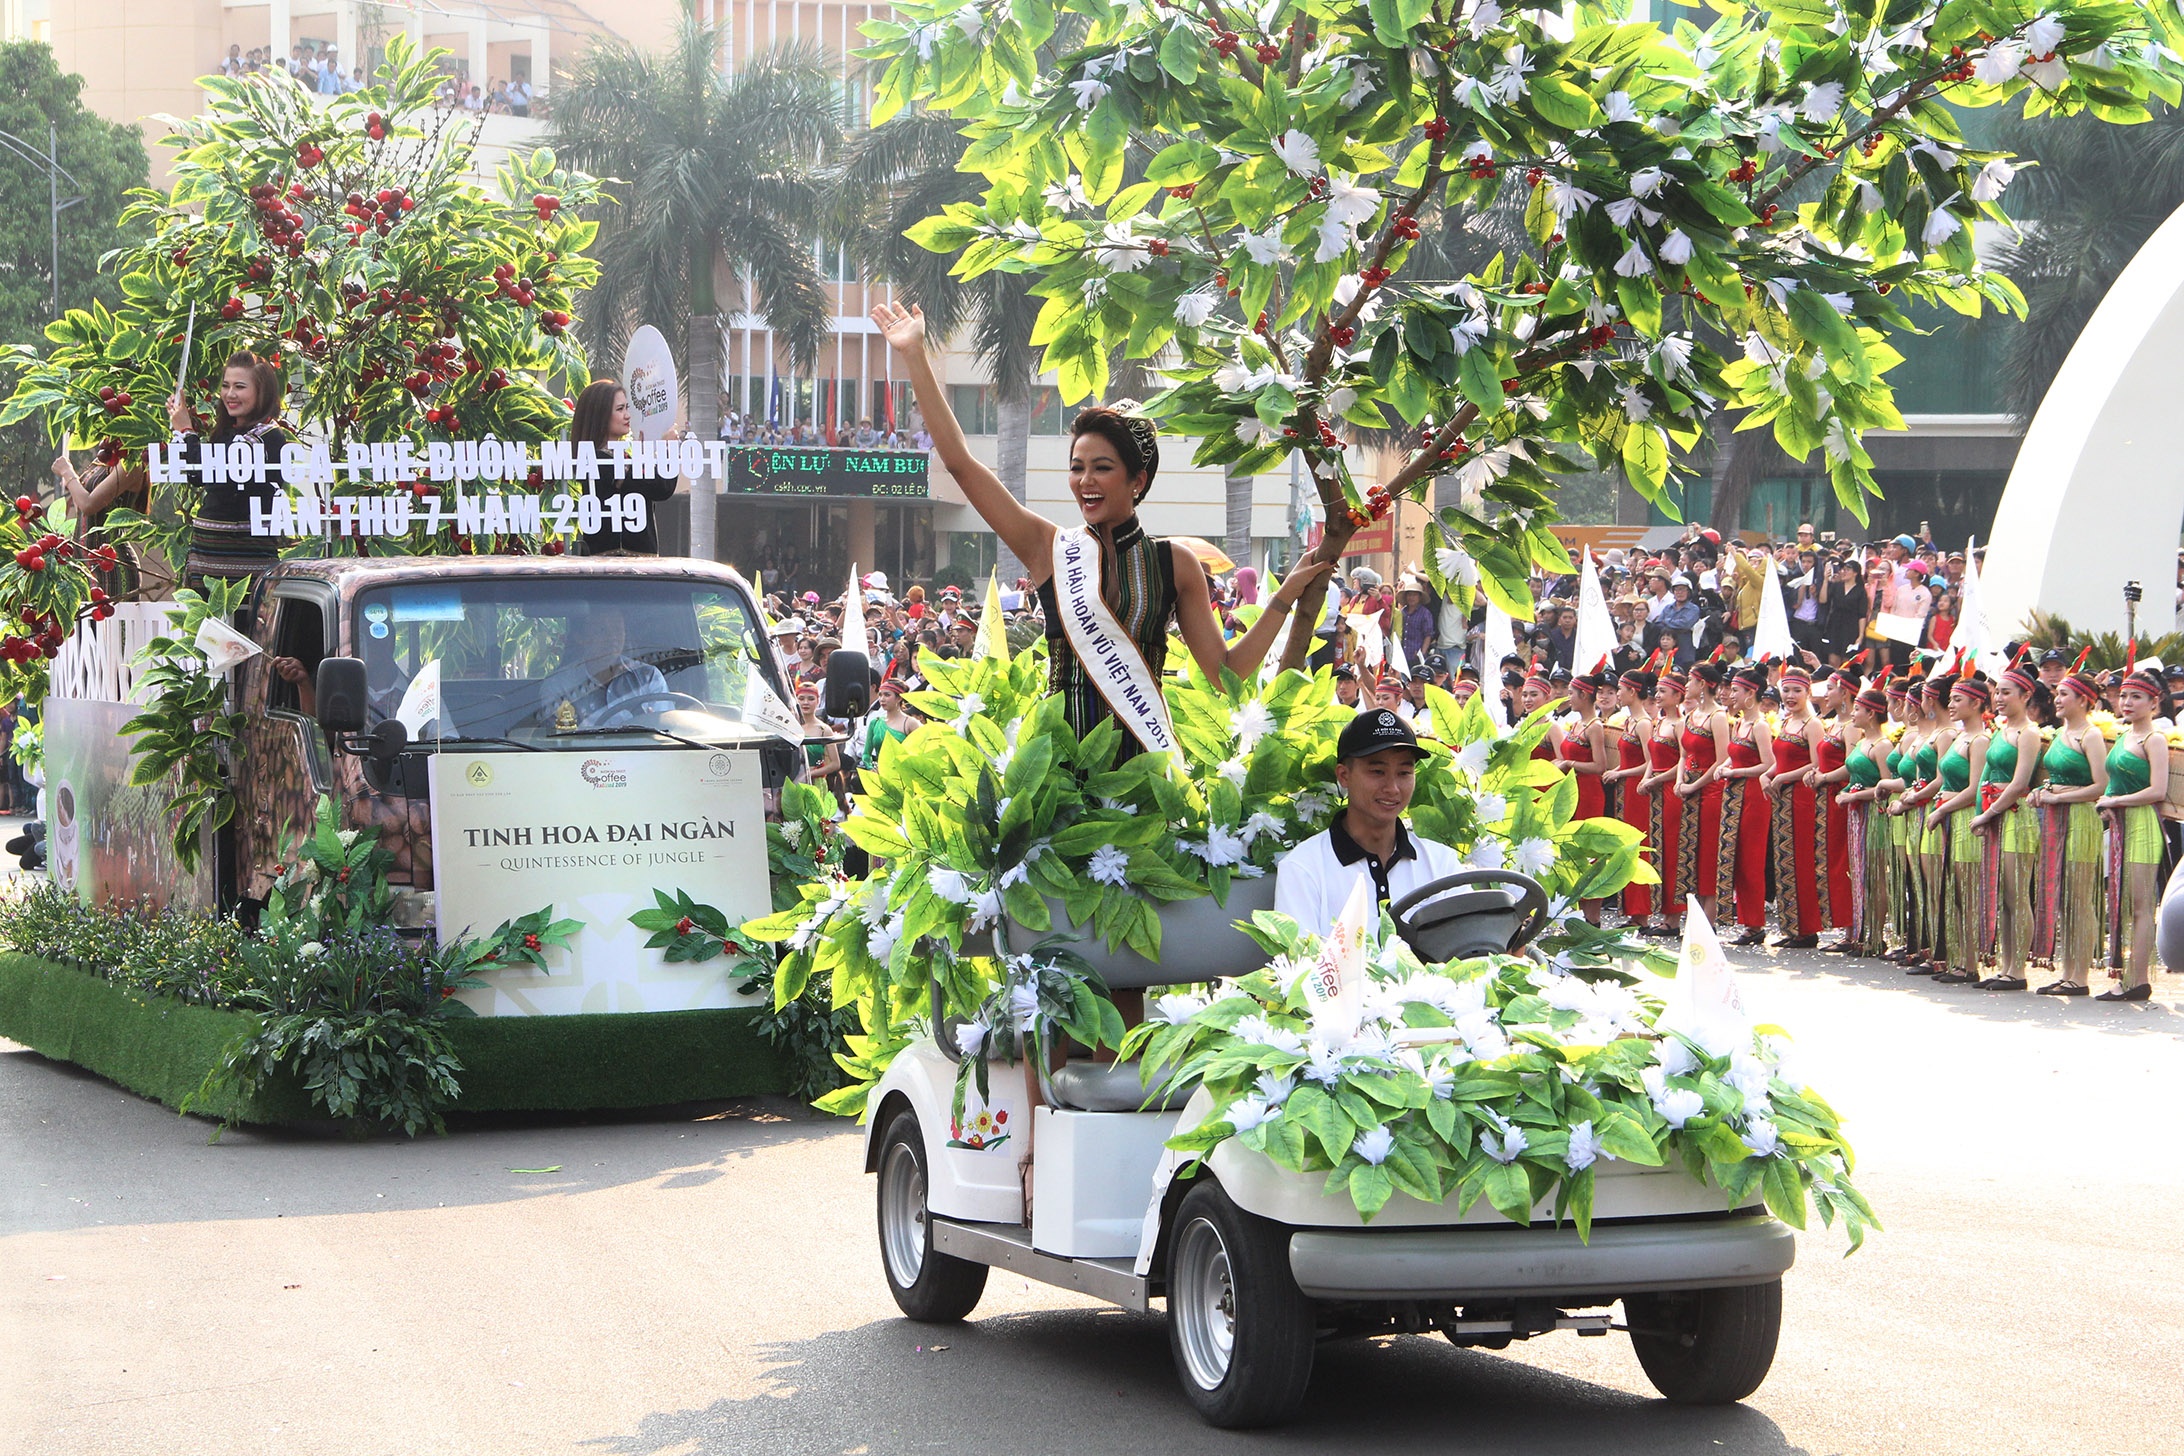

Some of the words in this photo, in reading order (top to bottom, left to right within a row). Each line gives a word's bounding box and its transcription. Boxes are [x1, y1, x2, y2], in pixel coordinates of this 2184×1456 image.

[200, 434, 267, 491] HỘI
[347, 434, 416, 483] PHÊ
[428, 432, 528, 482] BUÔN
[541, 440, 601, 480] MA
[607, 431, 726, 486] THUỘT
[844, 457, 890, 473] NAM
[891, 484, 902, 495] 02
[904, 482, 915, 495] LÊ
[249, 481, 322, 537] LẦN
[334, 488, 412, 537] THỨ
[424, 496, 441, 535] 7
[456, 487, 542, 536] NĂM
[552, 492, 647, 534] 2019
[1066, 566, 1087, 595] HẬU
[1071, 595, 1099, 636] HOÀN
[1092, 633, 1116, 655] VŨ
[1104, 652, 1132, 685] VIỆT
[1123, 683, 1151, 717] NAM
[1145, 717, 1170, 749] 2017
[463, 826, 534, 848] TINH
[541, 824, 600, 845] HOA
[606, 822, 652, 847] ĐẠI
[660, 815, 735, 841] NGÀN
[500, 854, 617, 872] QUINTESSENCE
[622, 853, 643, 866] OF
[648, 851, 705, 868] JUNGLE
